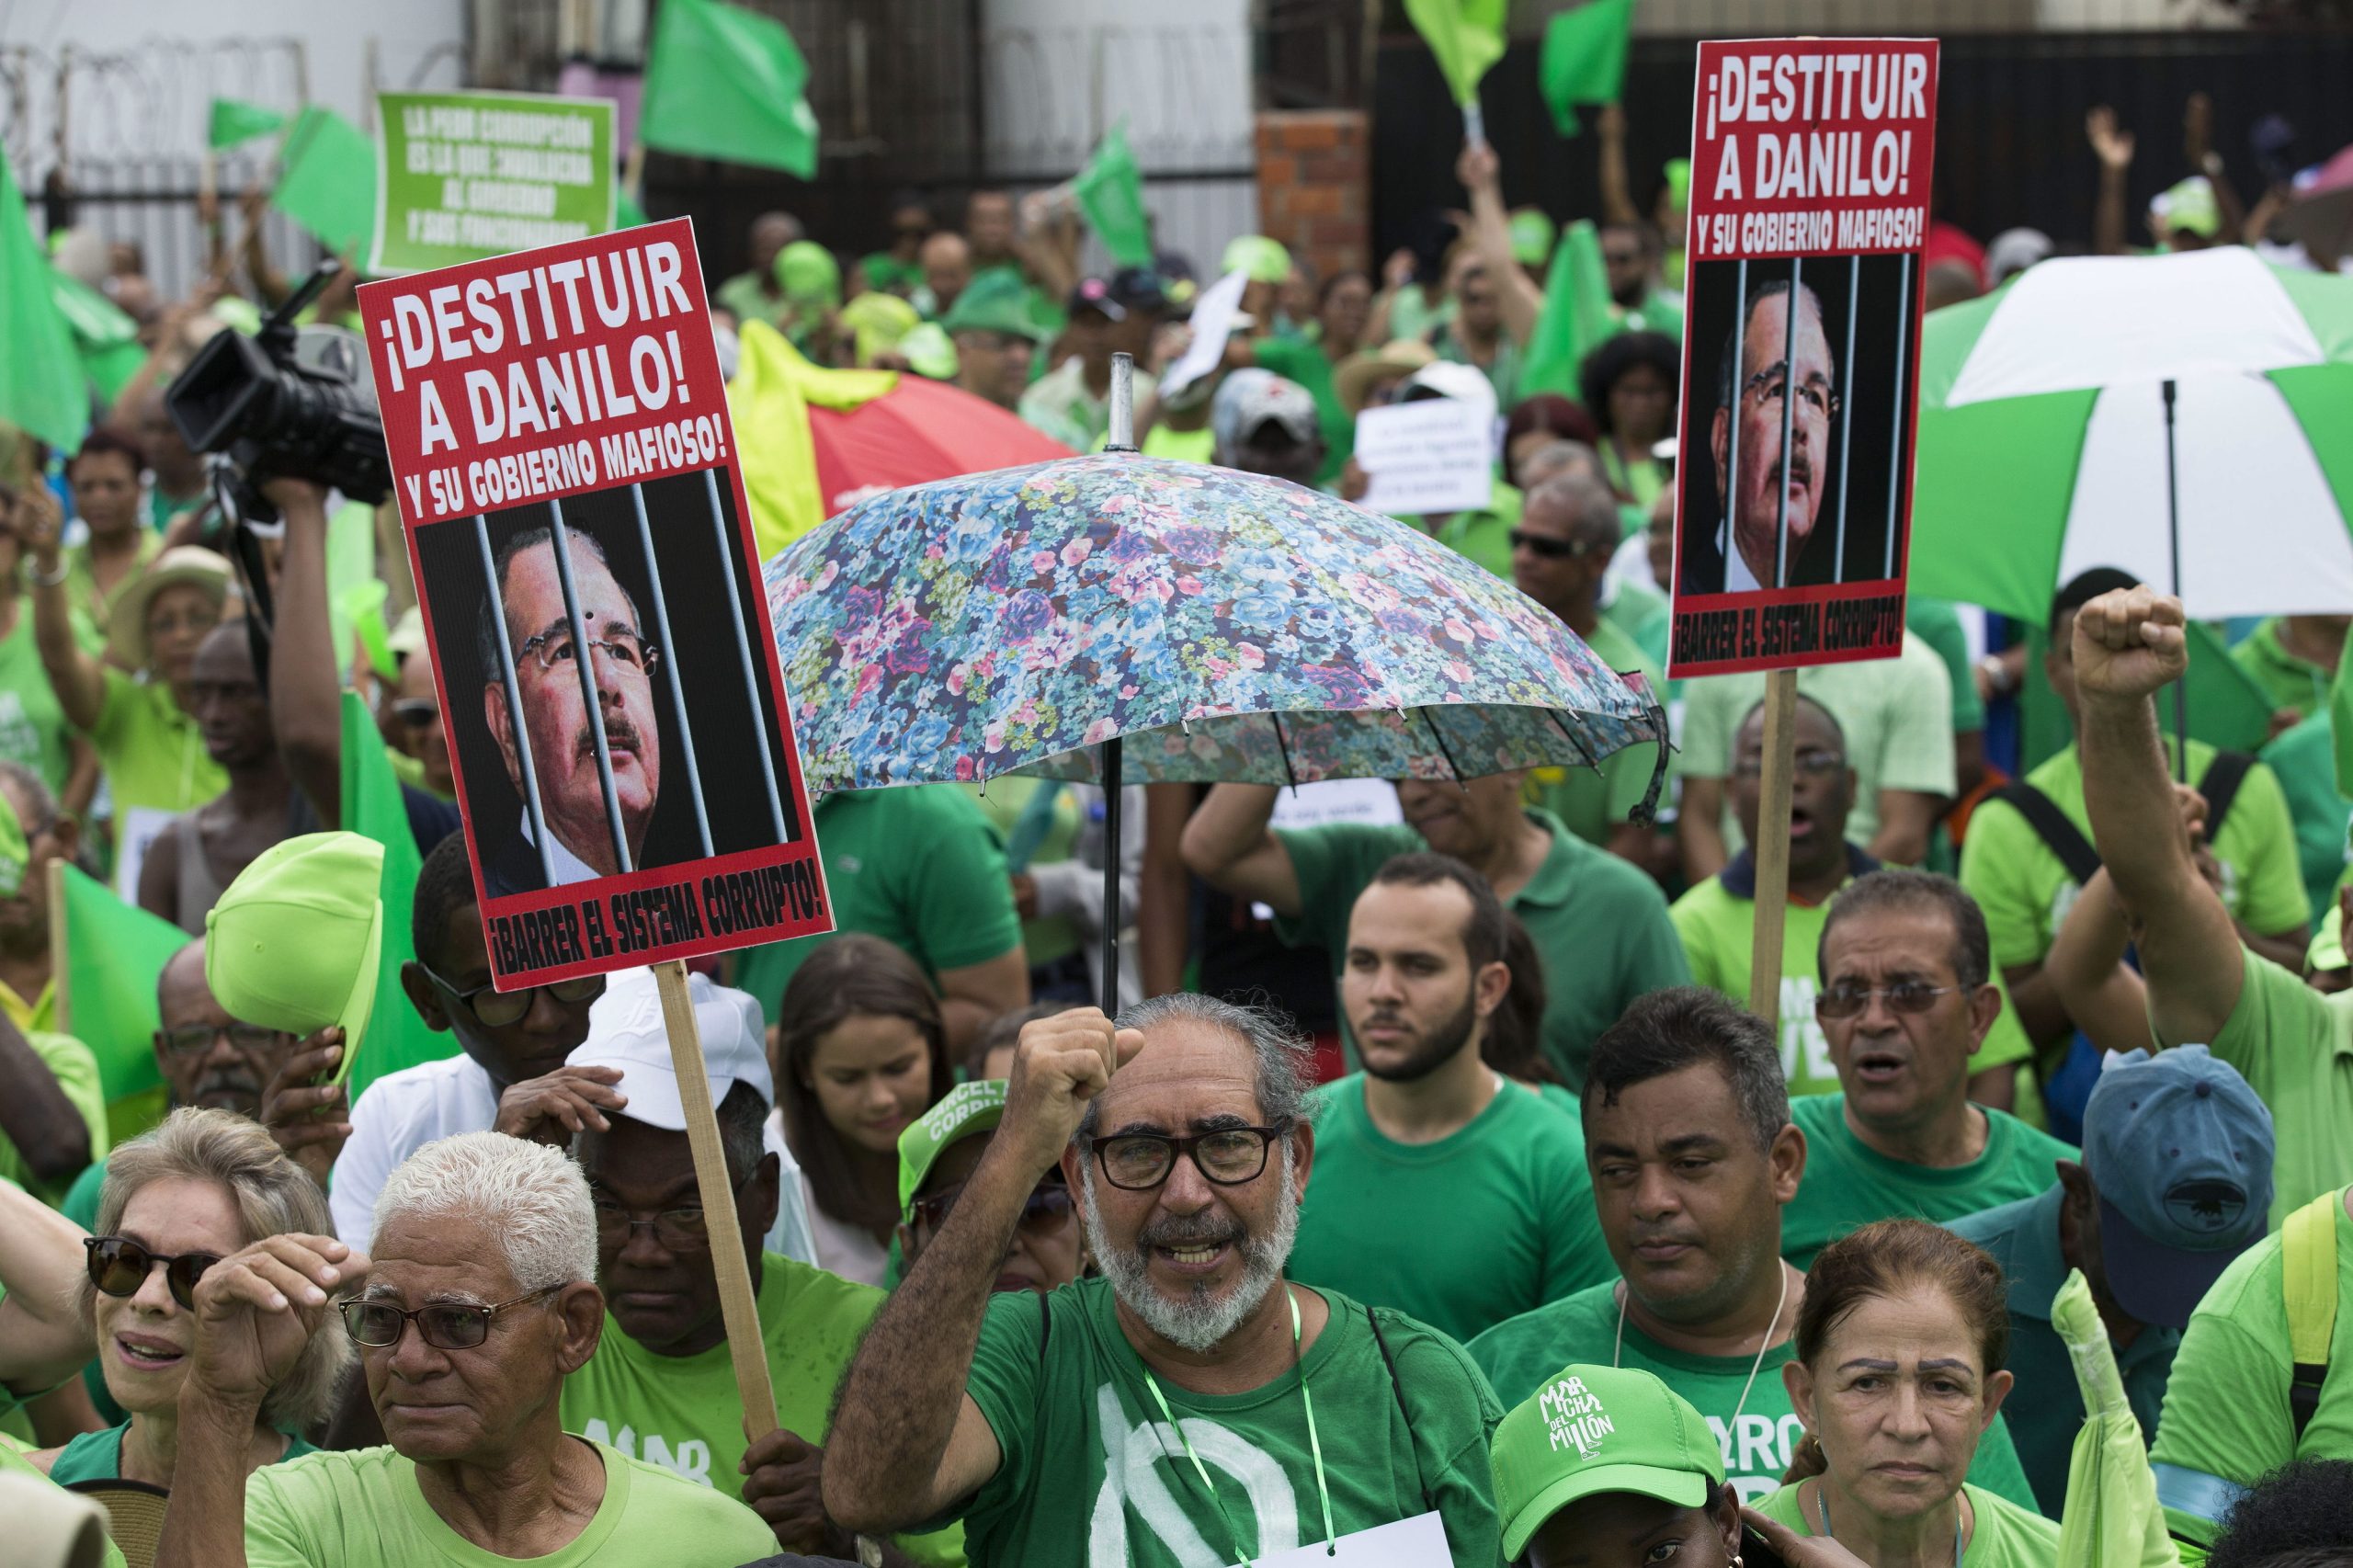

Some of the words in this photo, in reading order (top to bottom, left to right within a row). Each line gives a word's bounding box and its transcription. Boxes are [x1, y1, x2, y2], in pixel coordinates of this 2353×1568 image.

[1706, 53, 1927, 140] ¡DESTITUIR
[1713, 134, 1743, 200] A
[1755, 130, 1911, 199] DANILO!
[1697, 215, 1710, 255] Y
[1712, 213, 1737, 255] SU
[1742, 210, 1833, 254] GOBIERNO
[1837, 206, 1924, 249] MAFIOSO!
[381, 241, 693, 392] ¡DESTITUIR
[421, 381, 459, 456] A
[464, 331, 690, 445] DANILO!
[404, 474, 424, 519] Y
[428, 467, 465, 516] SU
[468, 439, 597, 507] GOBIERNO
[600, 413, 727, 480] MAFIOSO!
[1741, 608, 1756, 658] EL
[1761, 602, 1820, 657] SISTEMA
[1824, 594, 1903, 652] CORRUPTO!
[488, 904, 586, 976] ¡BARRER
[581, 899, 614, 959] EL
[611, 881, 704, 954] SISTEMA
[702, 858, 823, 937] CORRUPTO!
[1539, 1376, 1587, 1424] MAR
[1550, 1415, 1569, 1431] DEL
[1550, 1414, 1615, 1459] MILLÓN
